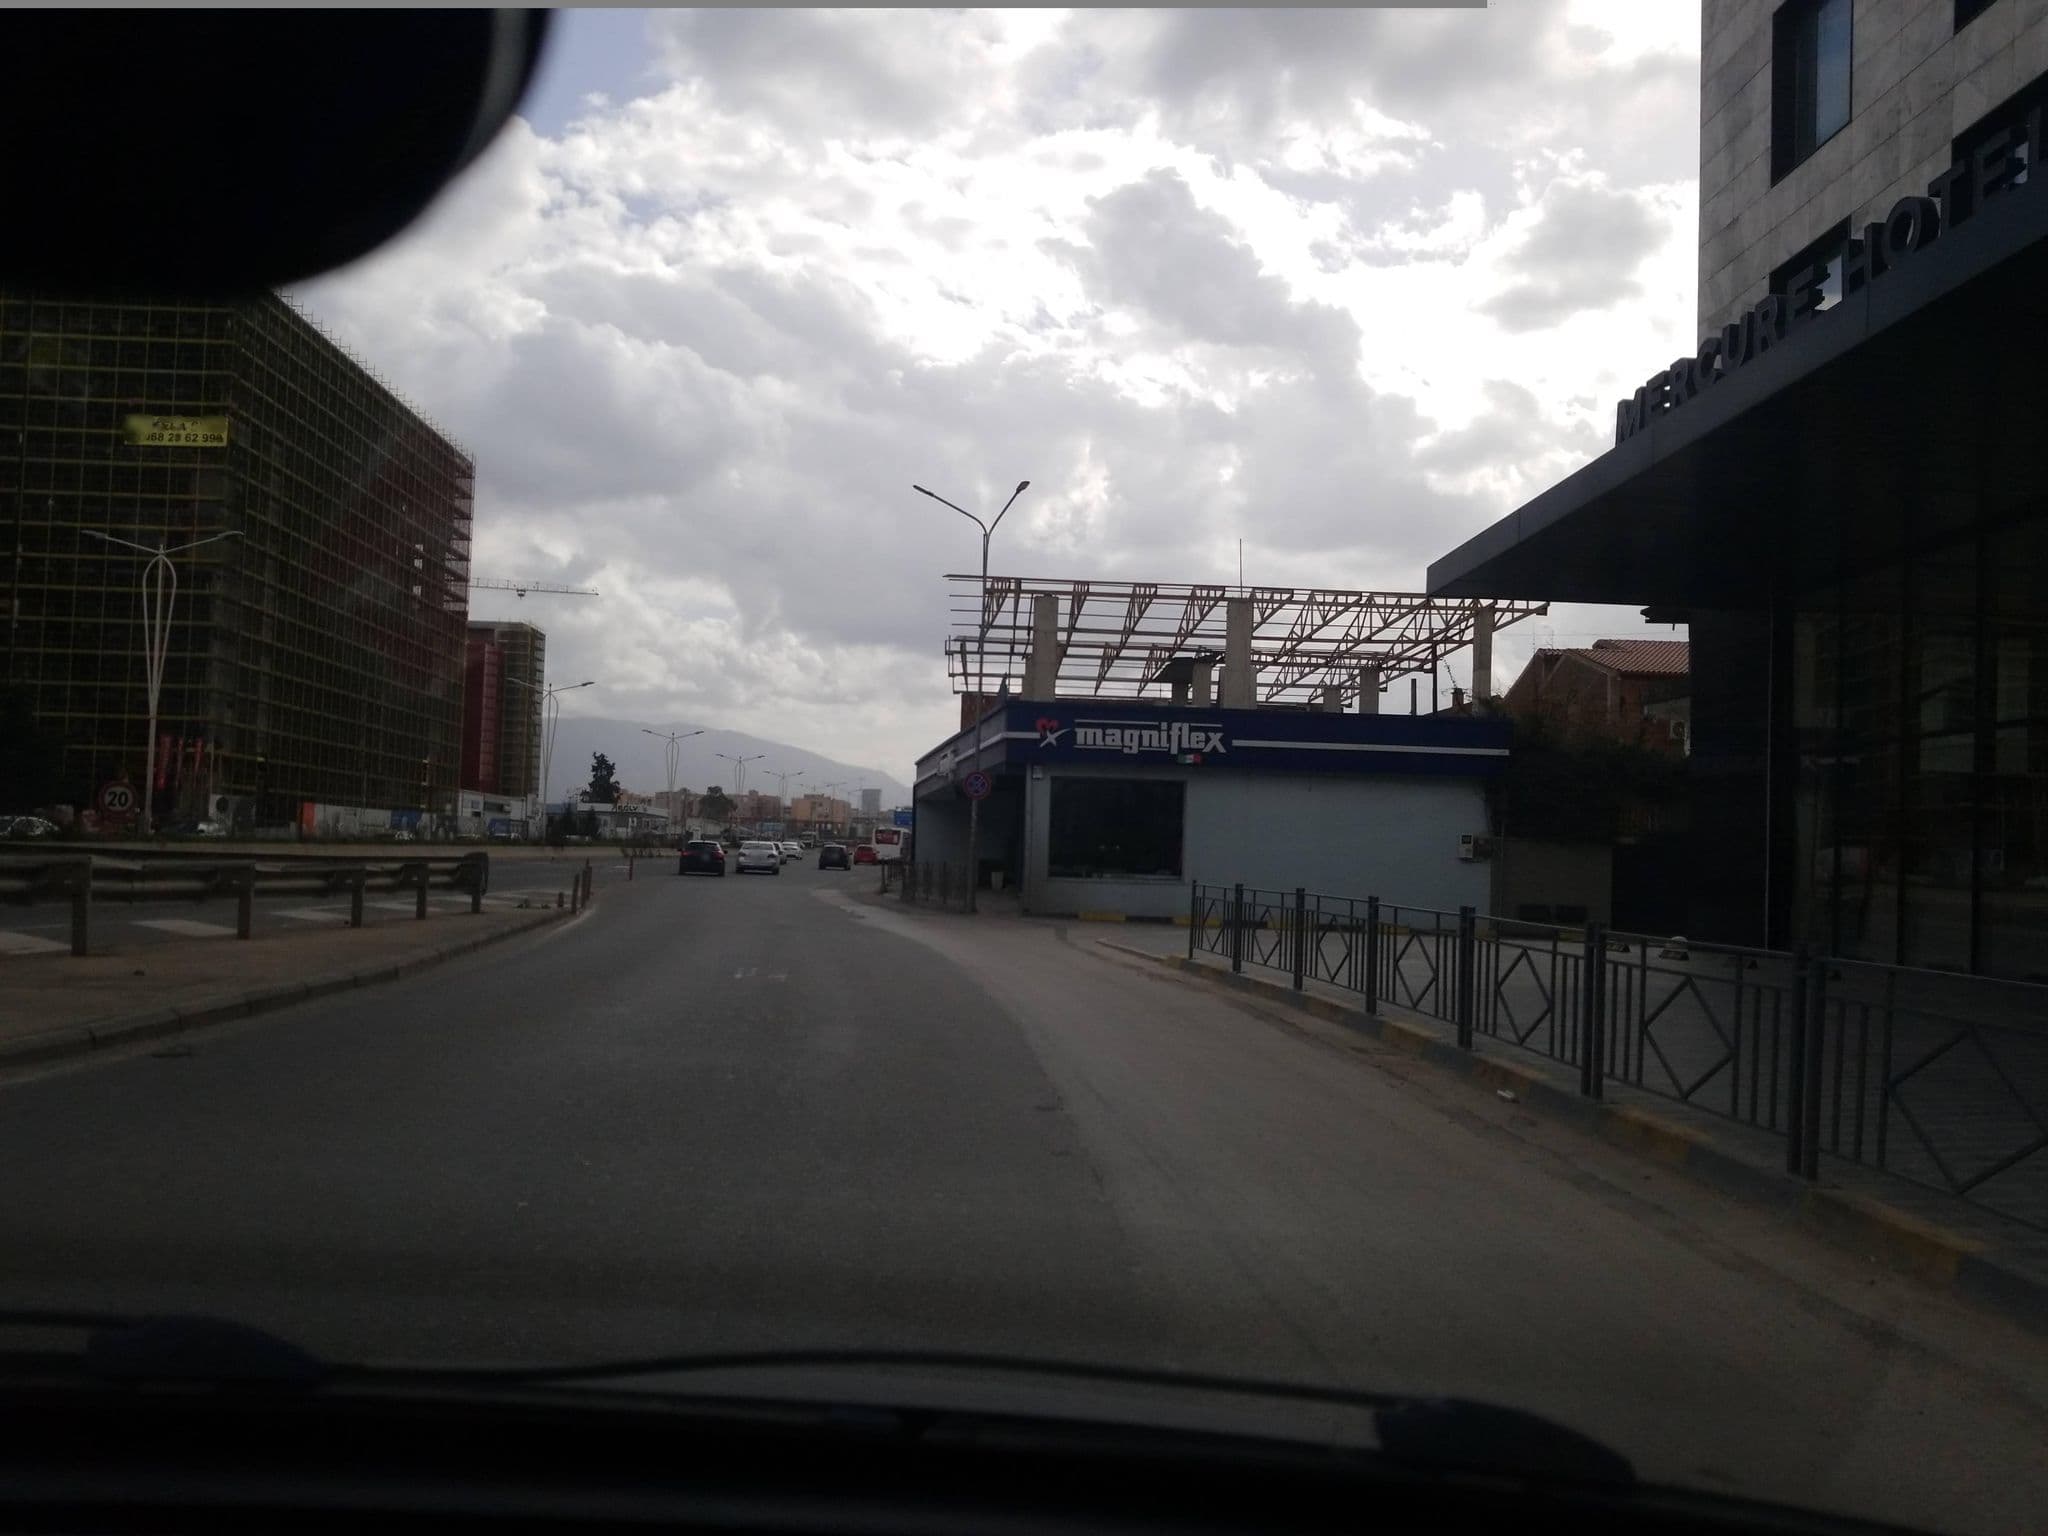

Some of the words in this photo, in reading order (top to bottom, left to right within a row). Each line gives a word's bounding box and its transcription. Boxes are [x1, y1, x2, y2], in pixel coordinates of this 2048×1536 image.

[1616, 263, 1831, 447] MERCURE
[1075, 721, 1226, 755] magniflex
[108, 791, 128, 807] 20
